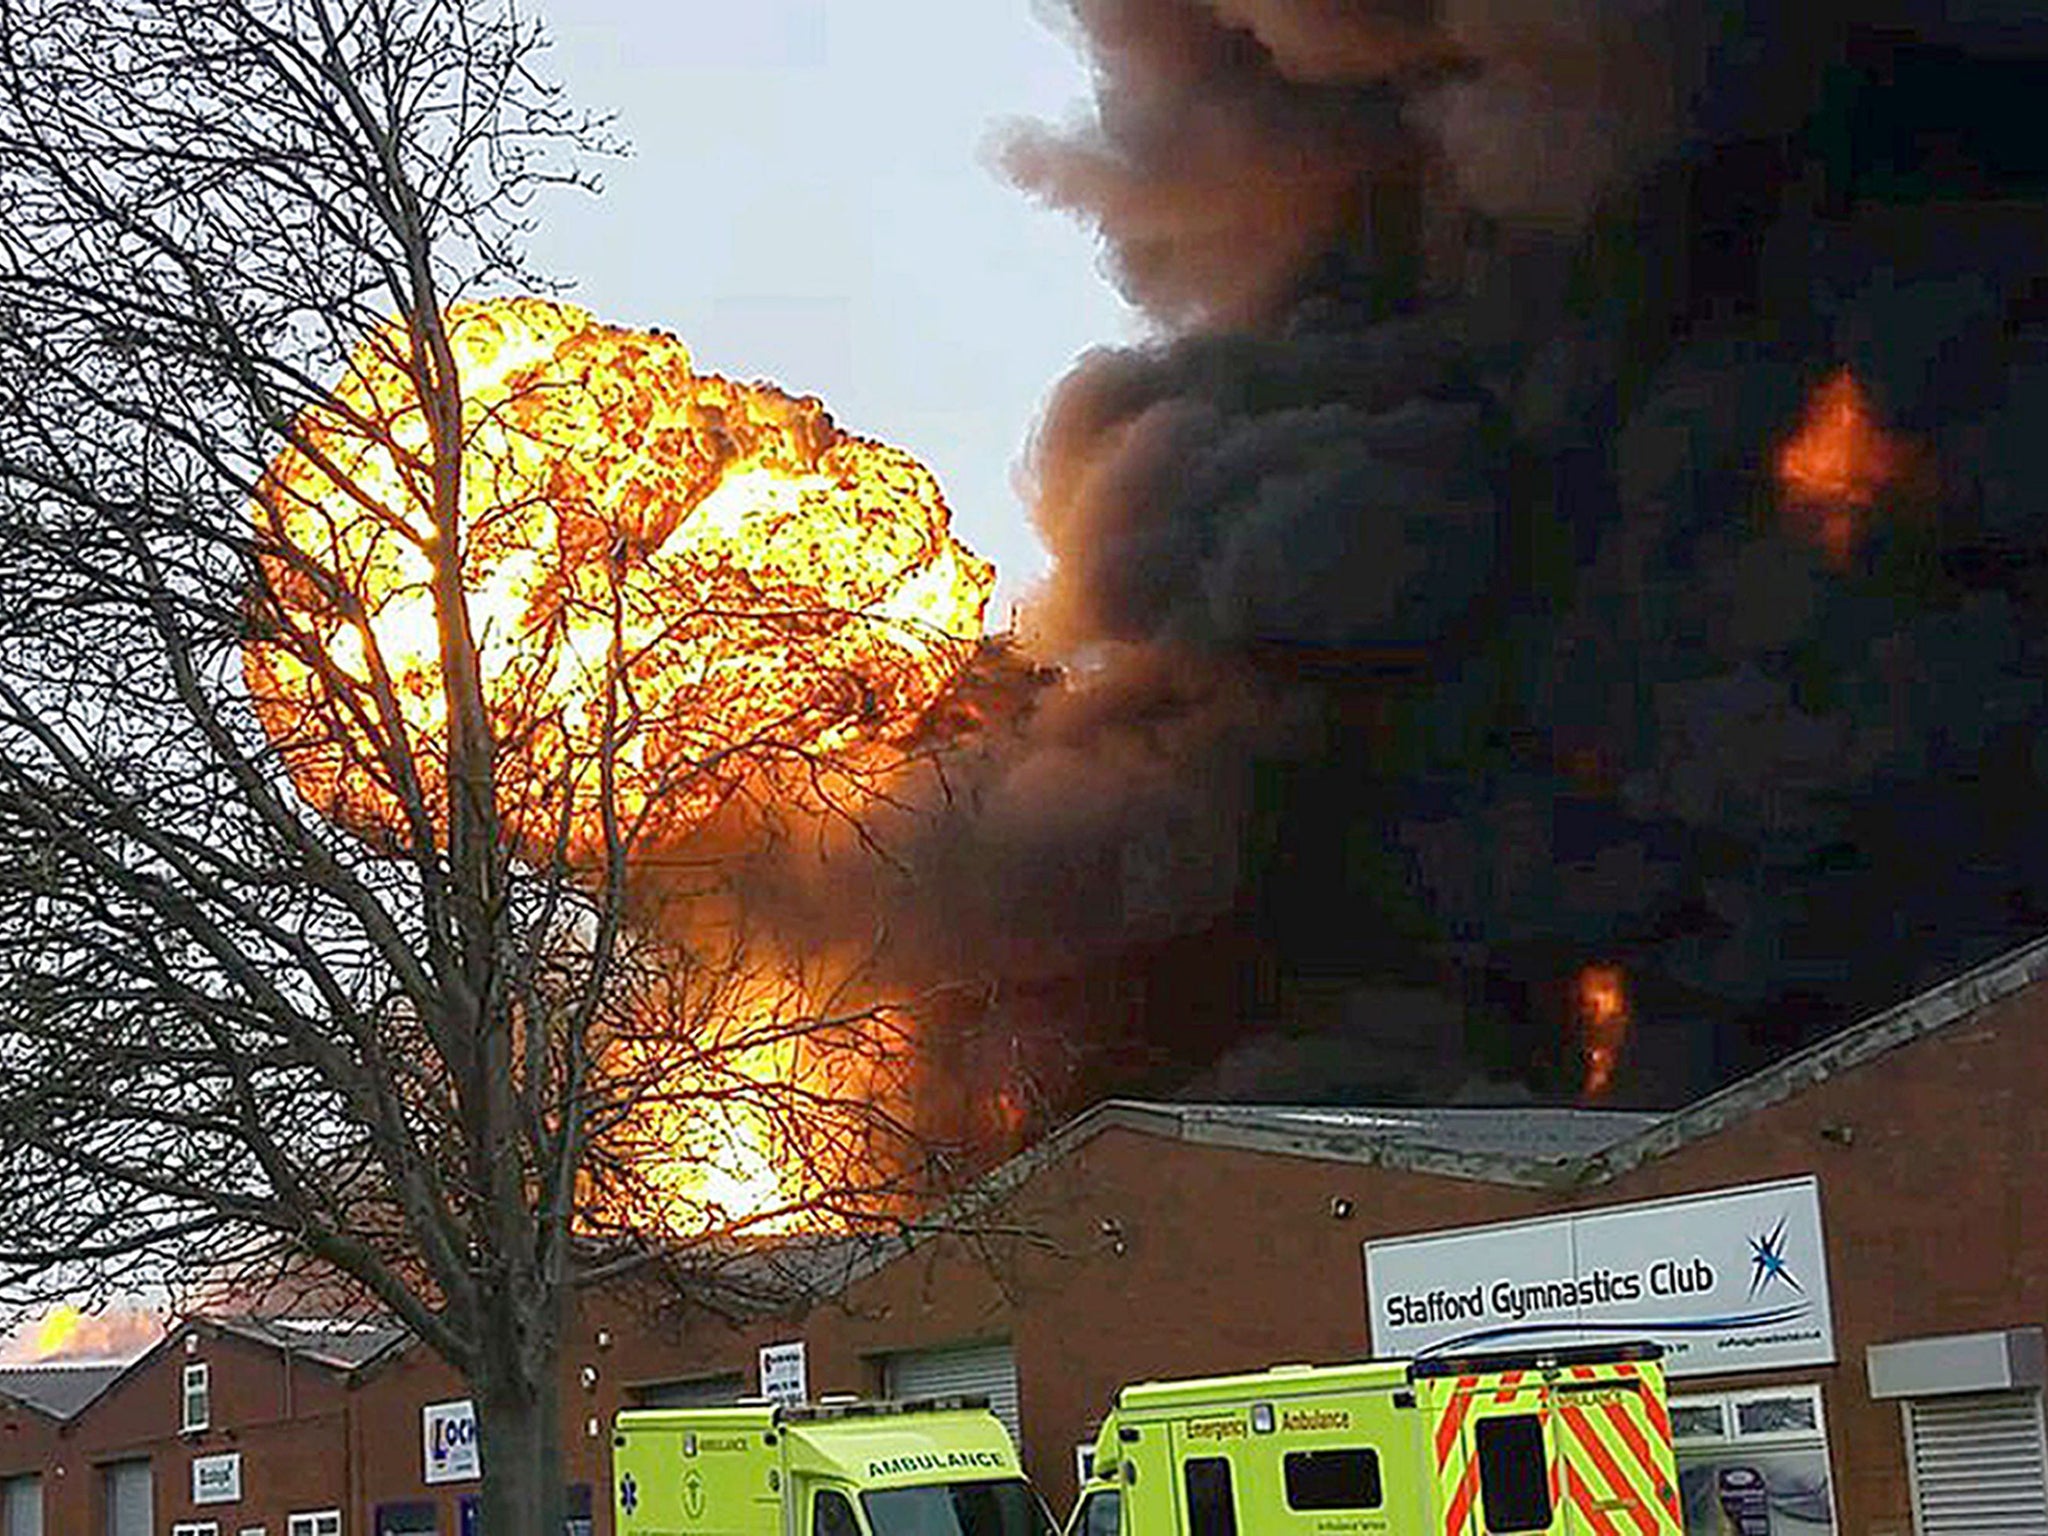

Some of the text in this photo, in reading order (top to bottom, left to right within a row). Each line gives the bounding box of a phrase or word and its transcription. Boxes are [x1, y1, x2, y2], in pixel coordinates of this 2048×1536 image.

[1387, 1258, 1713, 1326] Stafford Gymnastics Club
[1186, 1408, 1349, 1441] Emergency Ambulance
[868, 1452, 1006, 1478] AMBULANCE
